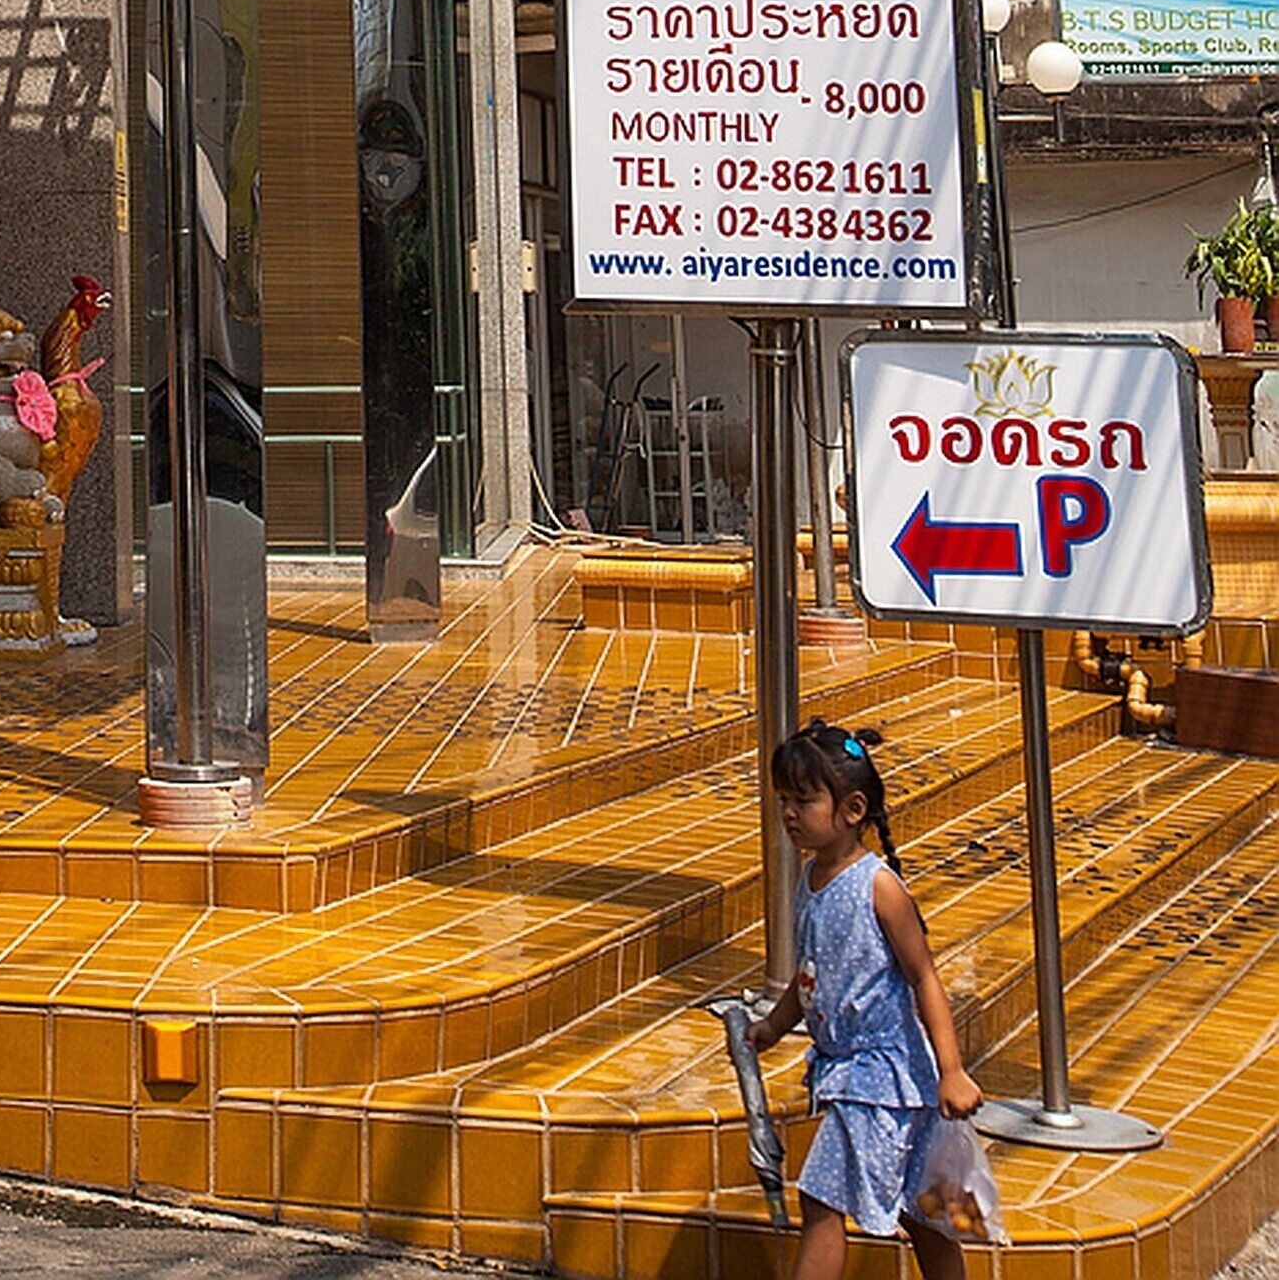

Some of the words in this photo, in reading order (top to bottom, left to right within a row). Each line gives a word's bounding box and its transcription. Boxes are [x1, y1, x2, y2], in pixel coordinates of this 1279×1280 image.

[1133, 8, 1236, 32] BUDGET
[1138, 38, 1199, 56] Sports
[606, 43, 800, 94] รายเดือน
[824, 82, 926, 121] 8,000
[611, 111, 780, 143] MONTHLY
[613, 156, 676, 189] TEL
[716, 158, 933, 195] 02-8621611
[717, 205, 934, 242] 02-4384362
[889, 414, 1148, 471] จอดรถ
[1035, 473, 1112, 579] P
